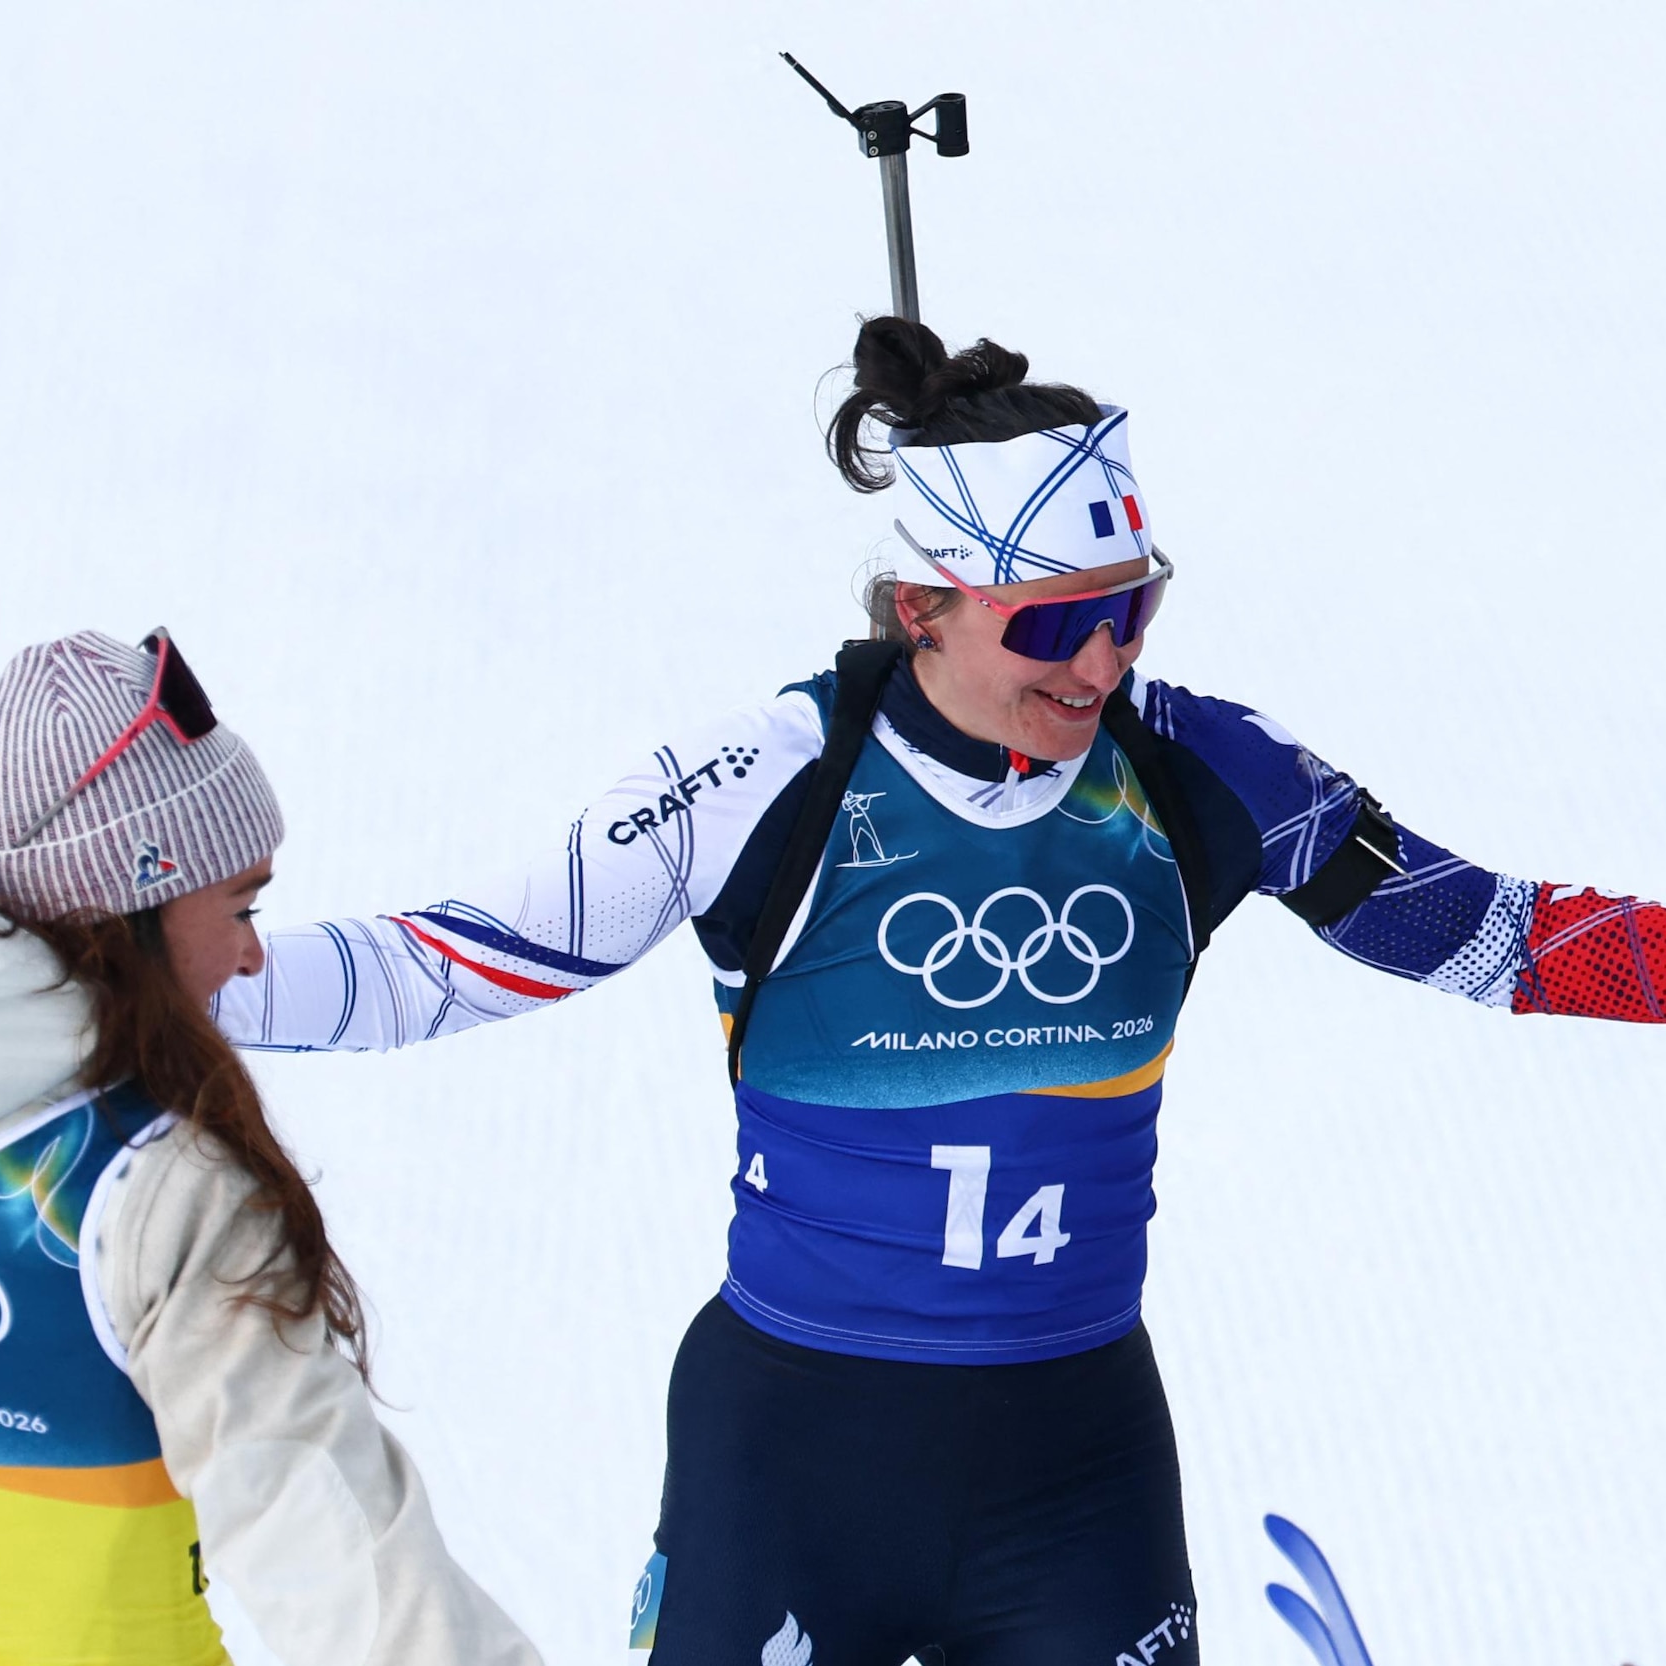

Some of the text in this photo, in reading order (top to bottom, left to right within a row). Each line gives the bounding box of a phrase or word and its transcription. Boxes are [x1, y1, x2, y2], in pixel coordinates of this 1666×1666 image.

[920, 546, 958, 559] RAFT
[607, 758, 723, 845] CRAFT
[850, 1014, 1154, 1050] MILANO CORTINA 2026
